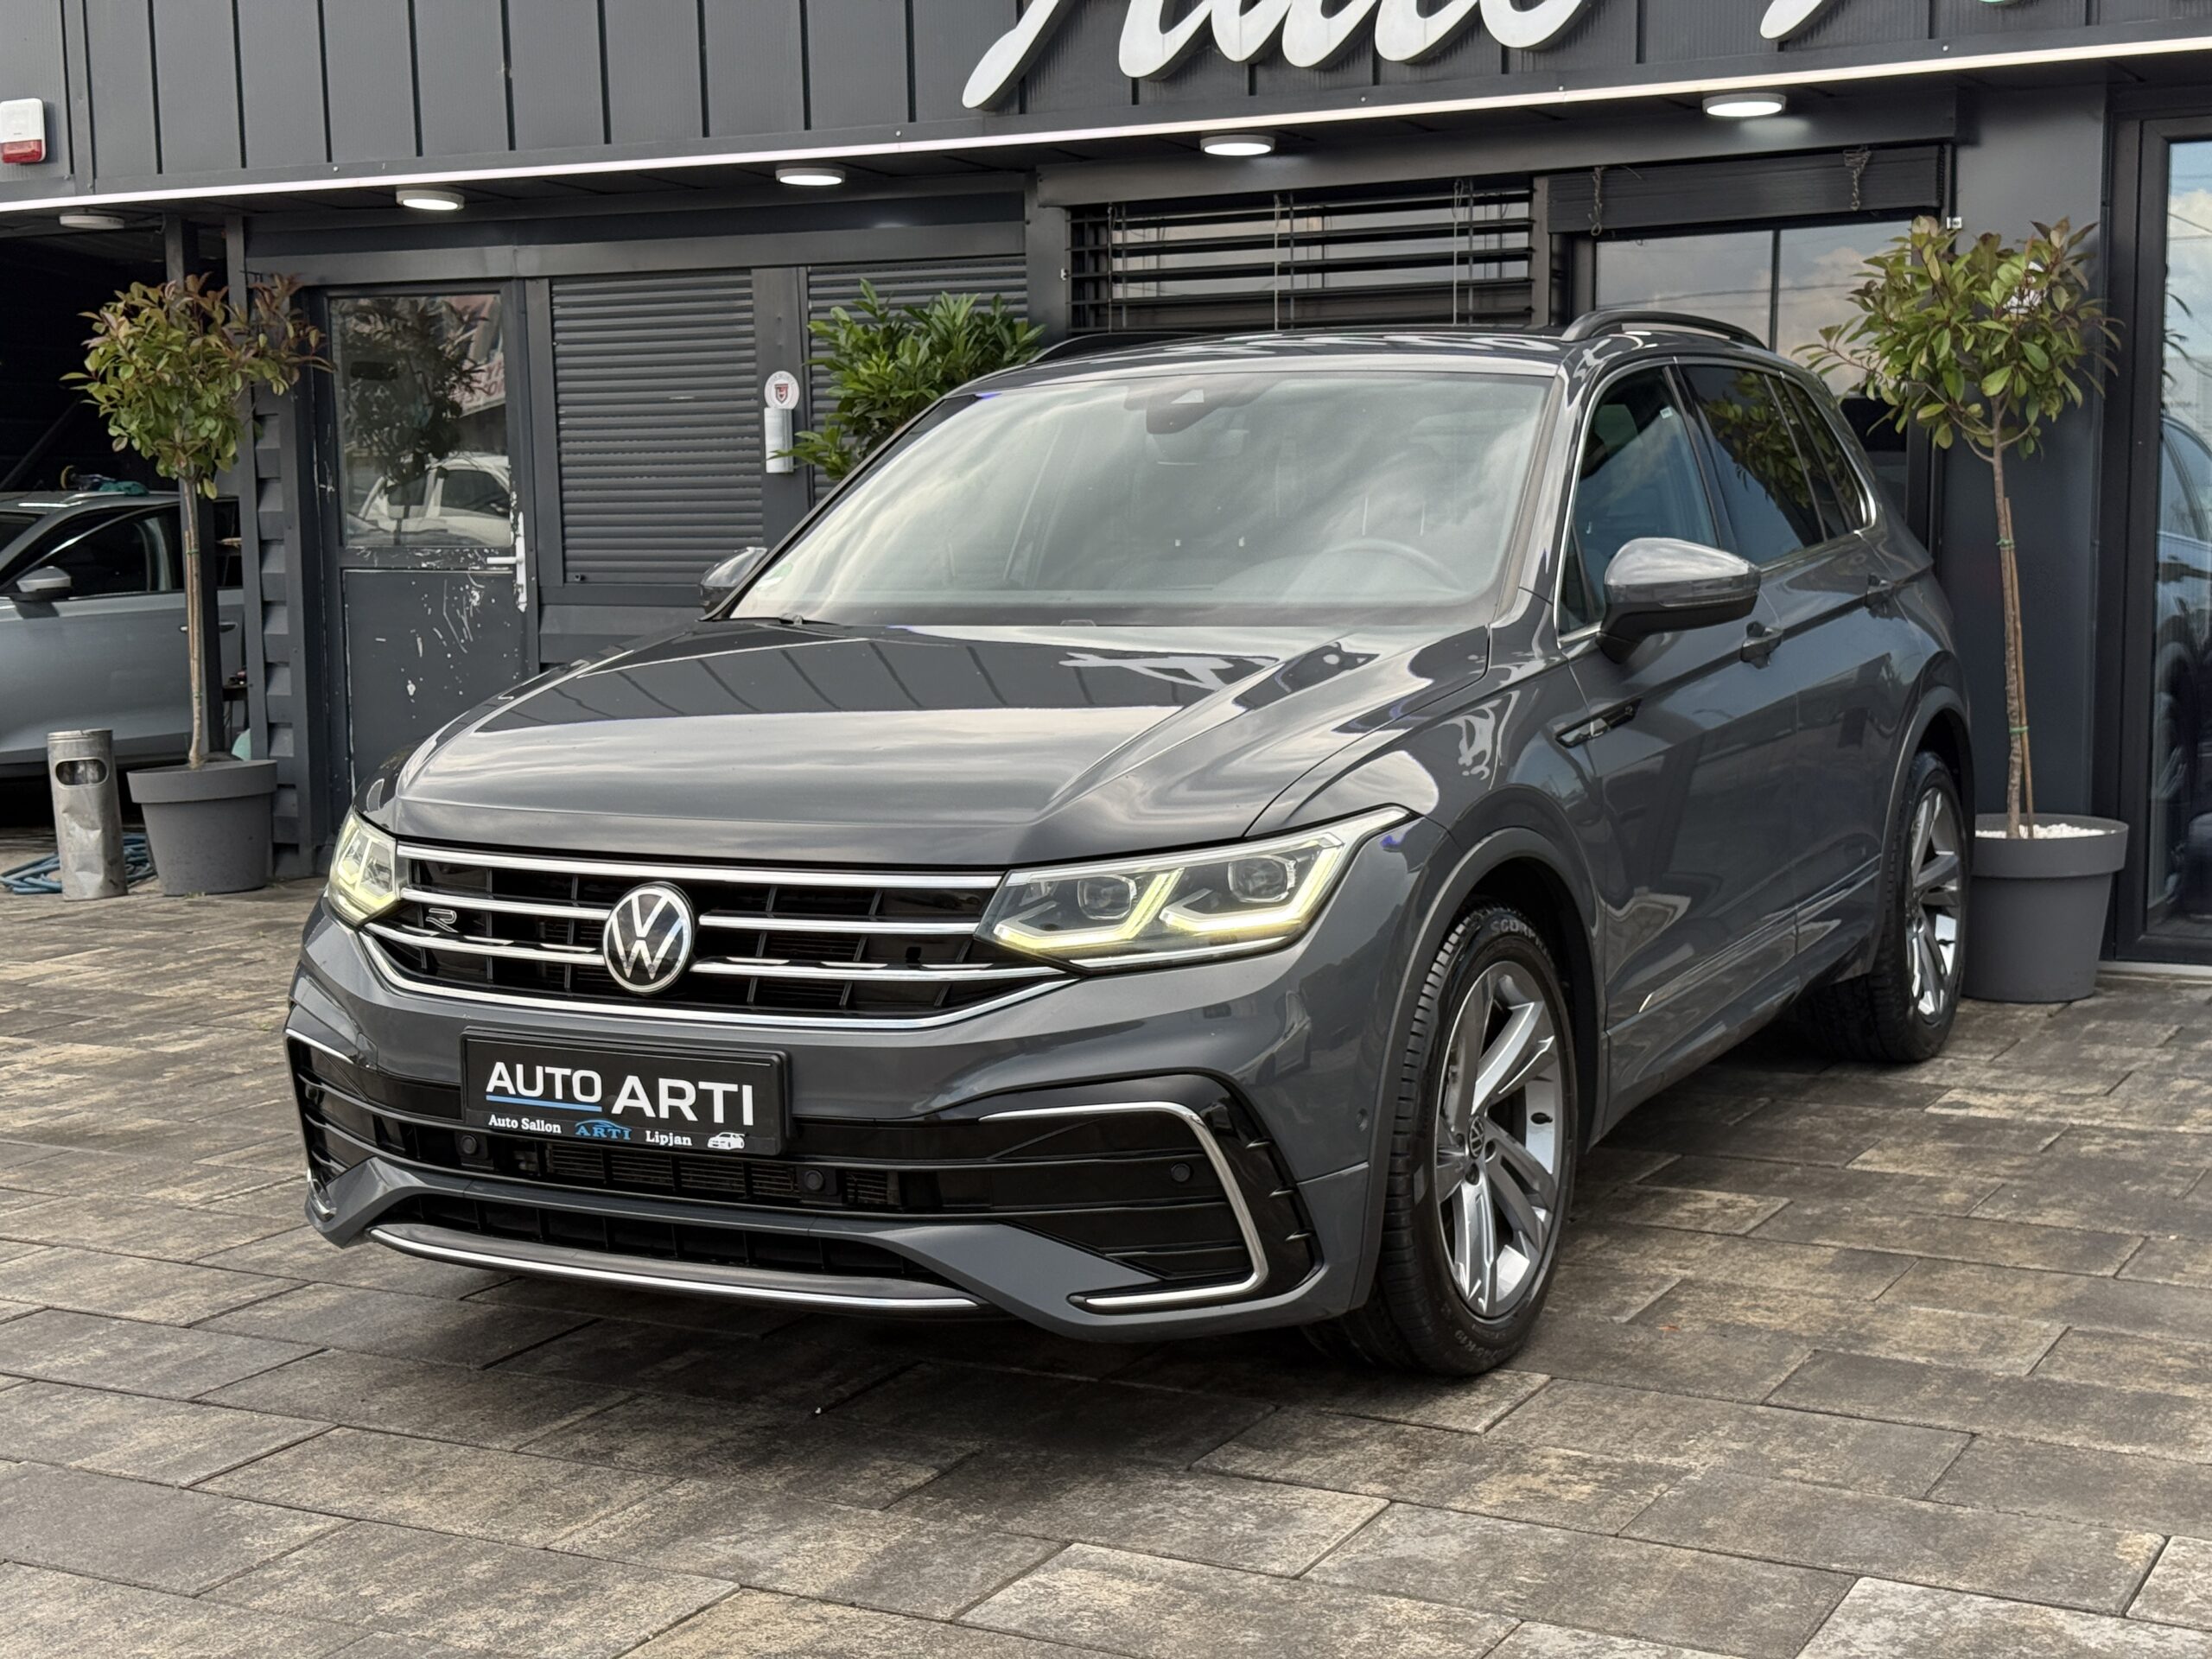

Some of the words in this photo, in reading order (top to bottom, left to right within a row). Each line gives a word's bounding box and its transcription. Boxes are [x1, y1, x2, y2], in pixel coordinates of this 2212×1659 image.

[608, 887, 689, 985] VW
[486, 1061, 603, 1104] AUTO
[611, 1075, 754, 1127] ARTI
[488, 1114, 518, 1129] Auto
[521, 1117, 563, 1135] Sallon
[575, 1124, 632, 1141] ARTI
[645, 1130, 692, 1147] Lipjan
